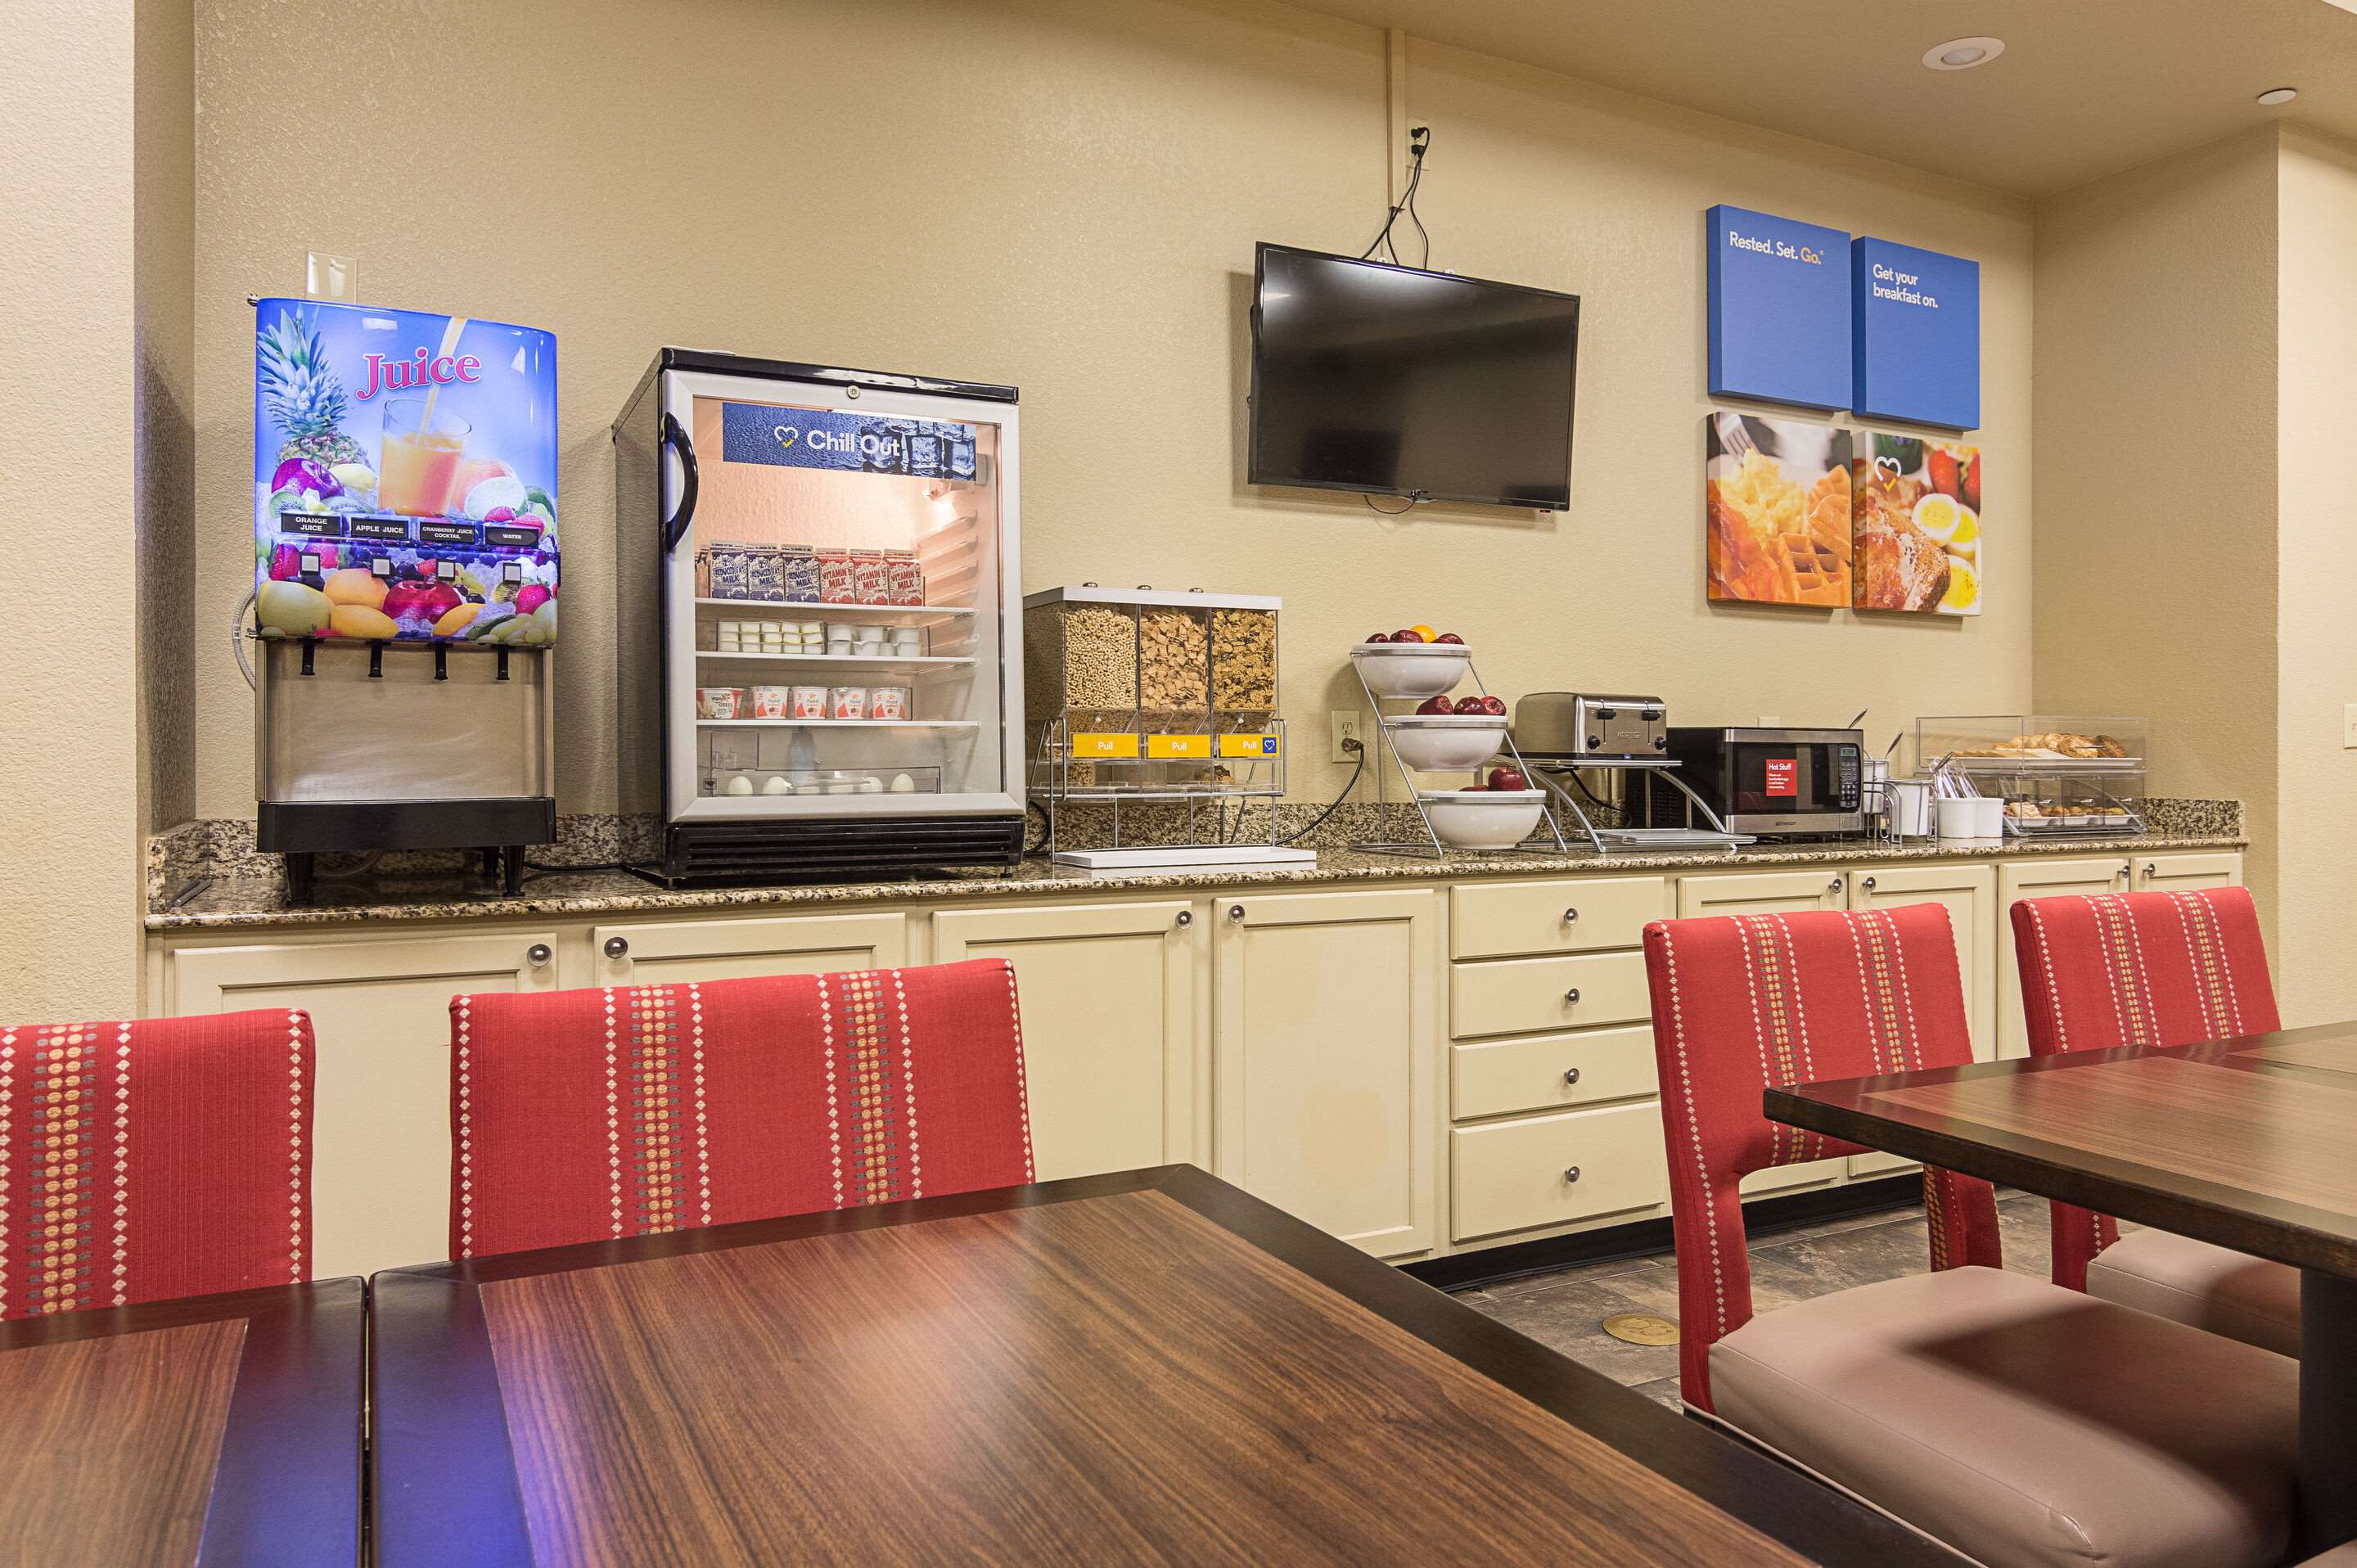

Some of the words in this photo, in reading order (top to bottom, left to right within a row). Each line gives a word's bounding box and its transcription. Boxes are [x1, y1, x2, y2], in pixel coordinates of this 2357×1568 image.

[1729, 231, 1773, 255] Rested.
[1776, 241, 1798, 259] Set.
[1873, 264, 1894, 281] Get
[1895, 269, 1918, 286] your
[1873, 282, 1921, 305] breakfast
[1922, 295, 1938, 309] on.
[355, 346, 481, 400] Juice
[807, 430, 855, 453] Chill
[860, 435, 899, 457] Out
[295, 516, 327, 525] ORANGE
[723, 574, 740, 583] MILK
[822, 569, 845, 580] VITAMIN
[856, 570, 881, 582] VITAMIN
[890, 570, 915, 583] VITAMIN
[759, 576, 775, 586] MILK
[796, 577, 813, 588] MILK
[828, 577, 846, 588] MILK
[863, 579, 880, 590] MILK
[897, 579, 914, 590] MILK
[1097, 741, 1113, 750] Pull
[1172, 741, 1187, 750] Pull
[1243, 740, 1257, 750] Pull
[1769, 763, 1778, 771] Hot
[1779, 763, 1792, 771] Stuff
